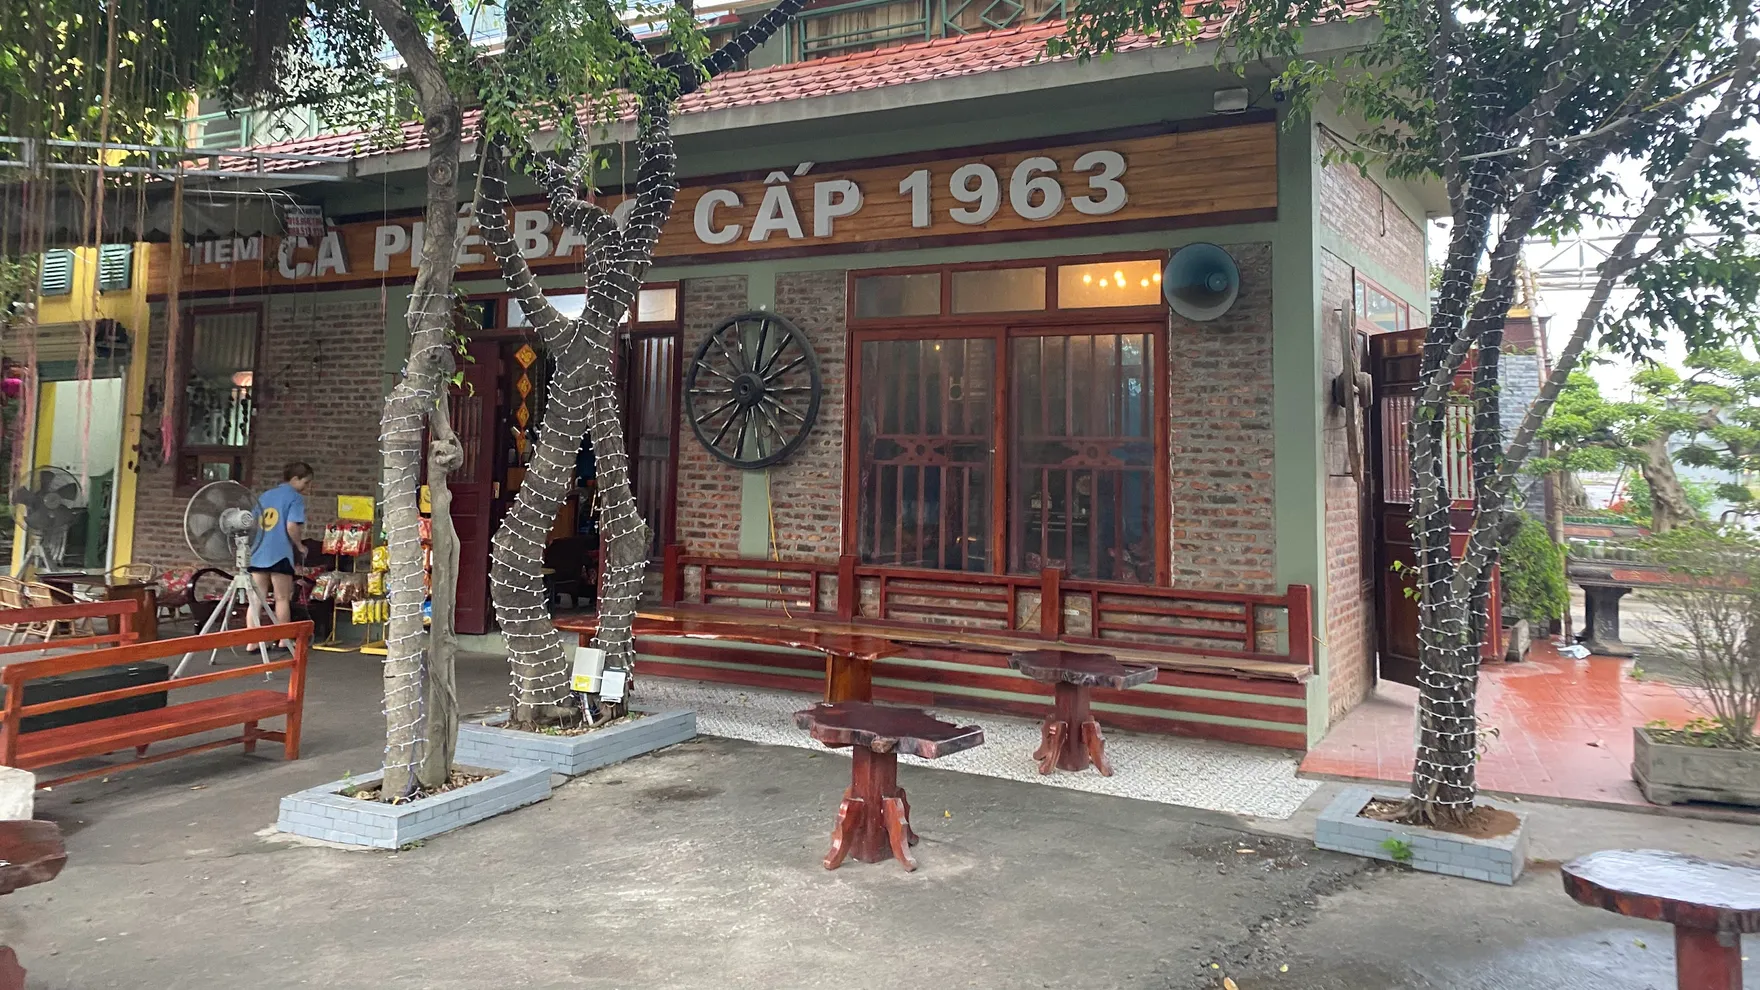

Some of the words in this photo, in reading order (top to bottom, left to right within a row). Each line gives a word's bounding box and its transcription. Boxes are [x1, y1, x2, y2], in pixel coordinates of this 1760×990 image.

[278, 217, 349, 280] CÀ
[693, 161, 865, 244] CẤP
[899, 150, 1128, 228] 1963
